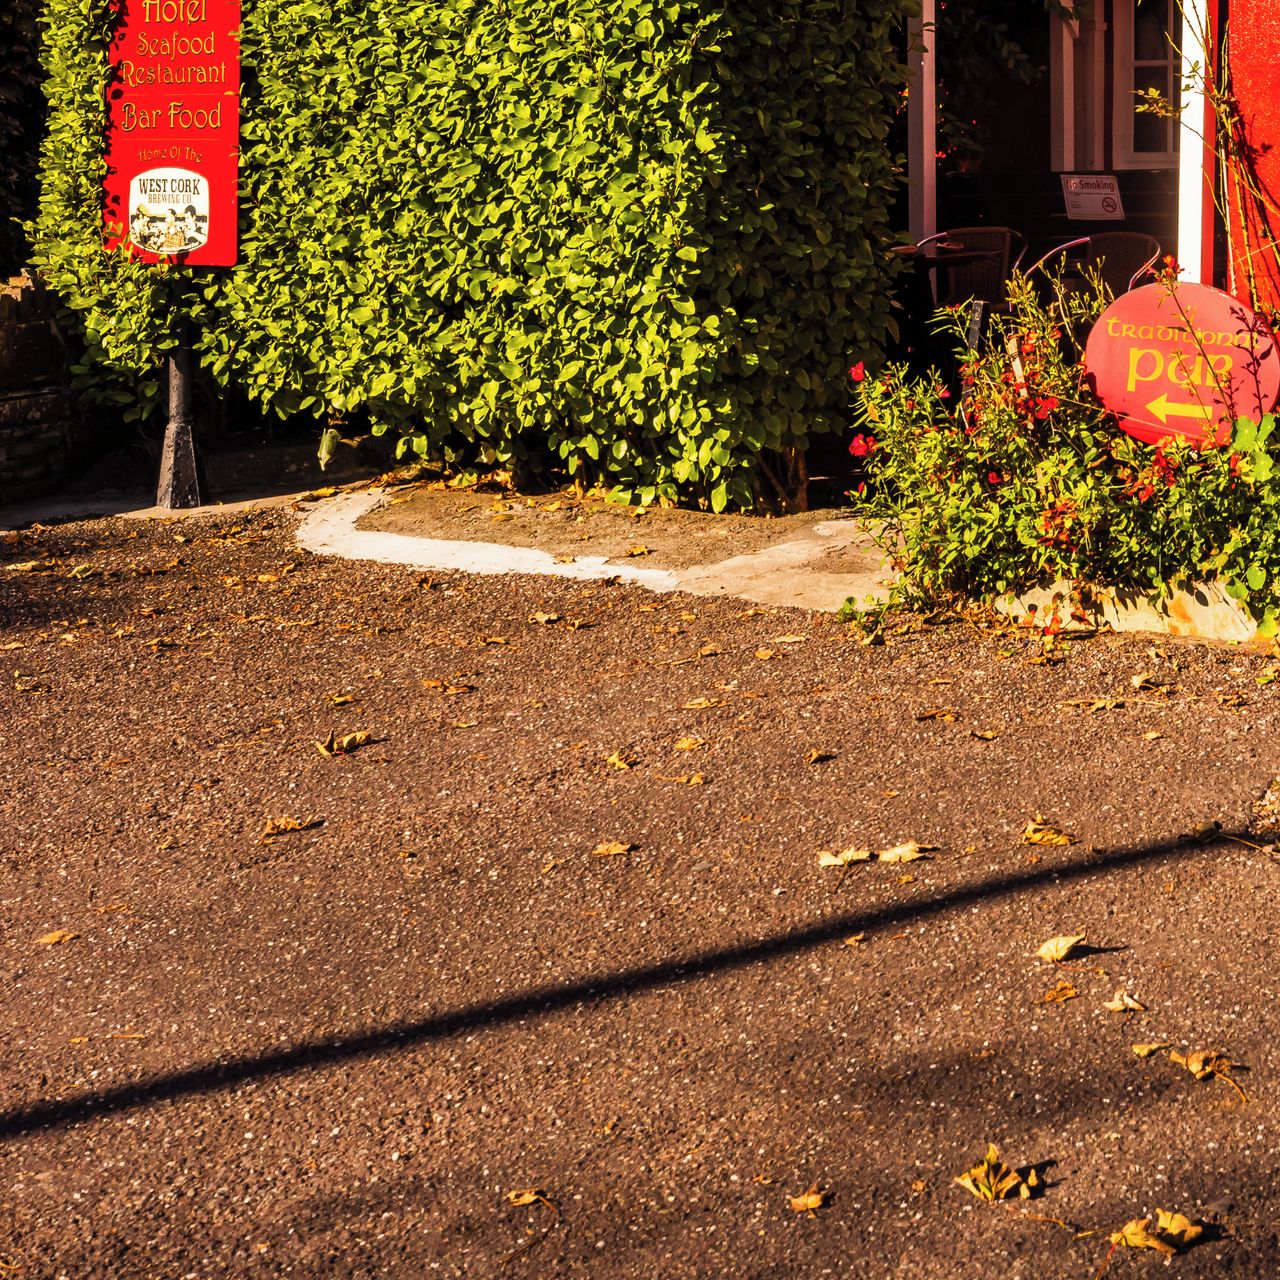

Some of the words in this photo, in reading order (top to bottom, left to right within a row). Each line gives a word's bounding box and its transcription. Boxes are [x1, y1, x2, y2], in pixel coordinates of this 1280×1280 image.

[136, 31, 215, 60] Seafood
[120, 60, 226, 88] Restaurant
[121, 102, 162, 131] Bar
[167, 100, 221, 129] Food
[138, 148, 167, 162] Home
[169, 145, 182, 161] Of
[185, 146, 203, 163] The
[138, 178, 168, 195] WEST
[170, 178, 201, 195] CORK
[1065, 179, 1078, 190] No
[1079, 179, 1115, 192] Smoking
[148, 193, 180, 204] BREWING
